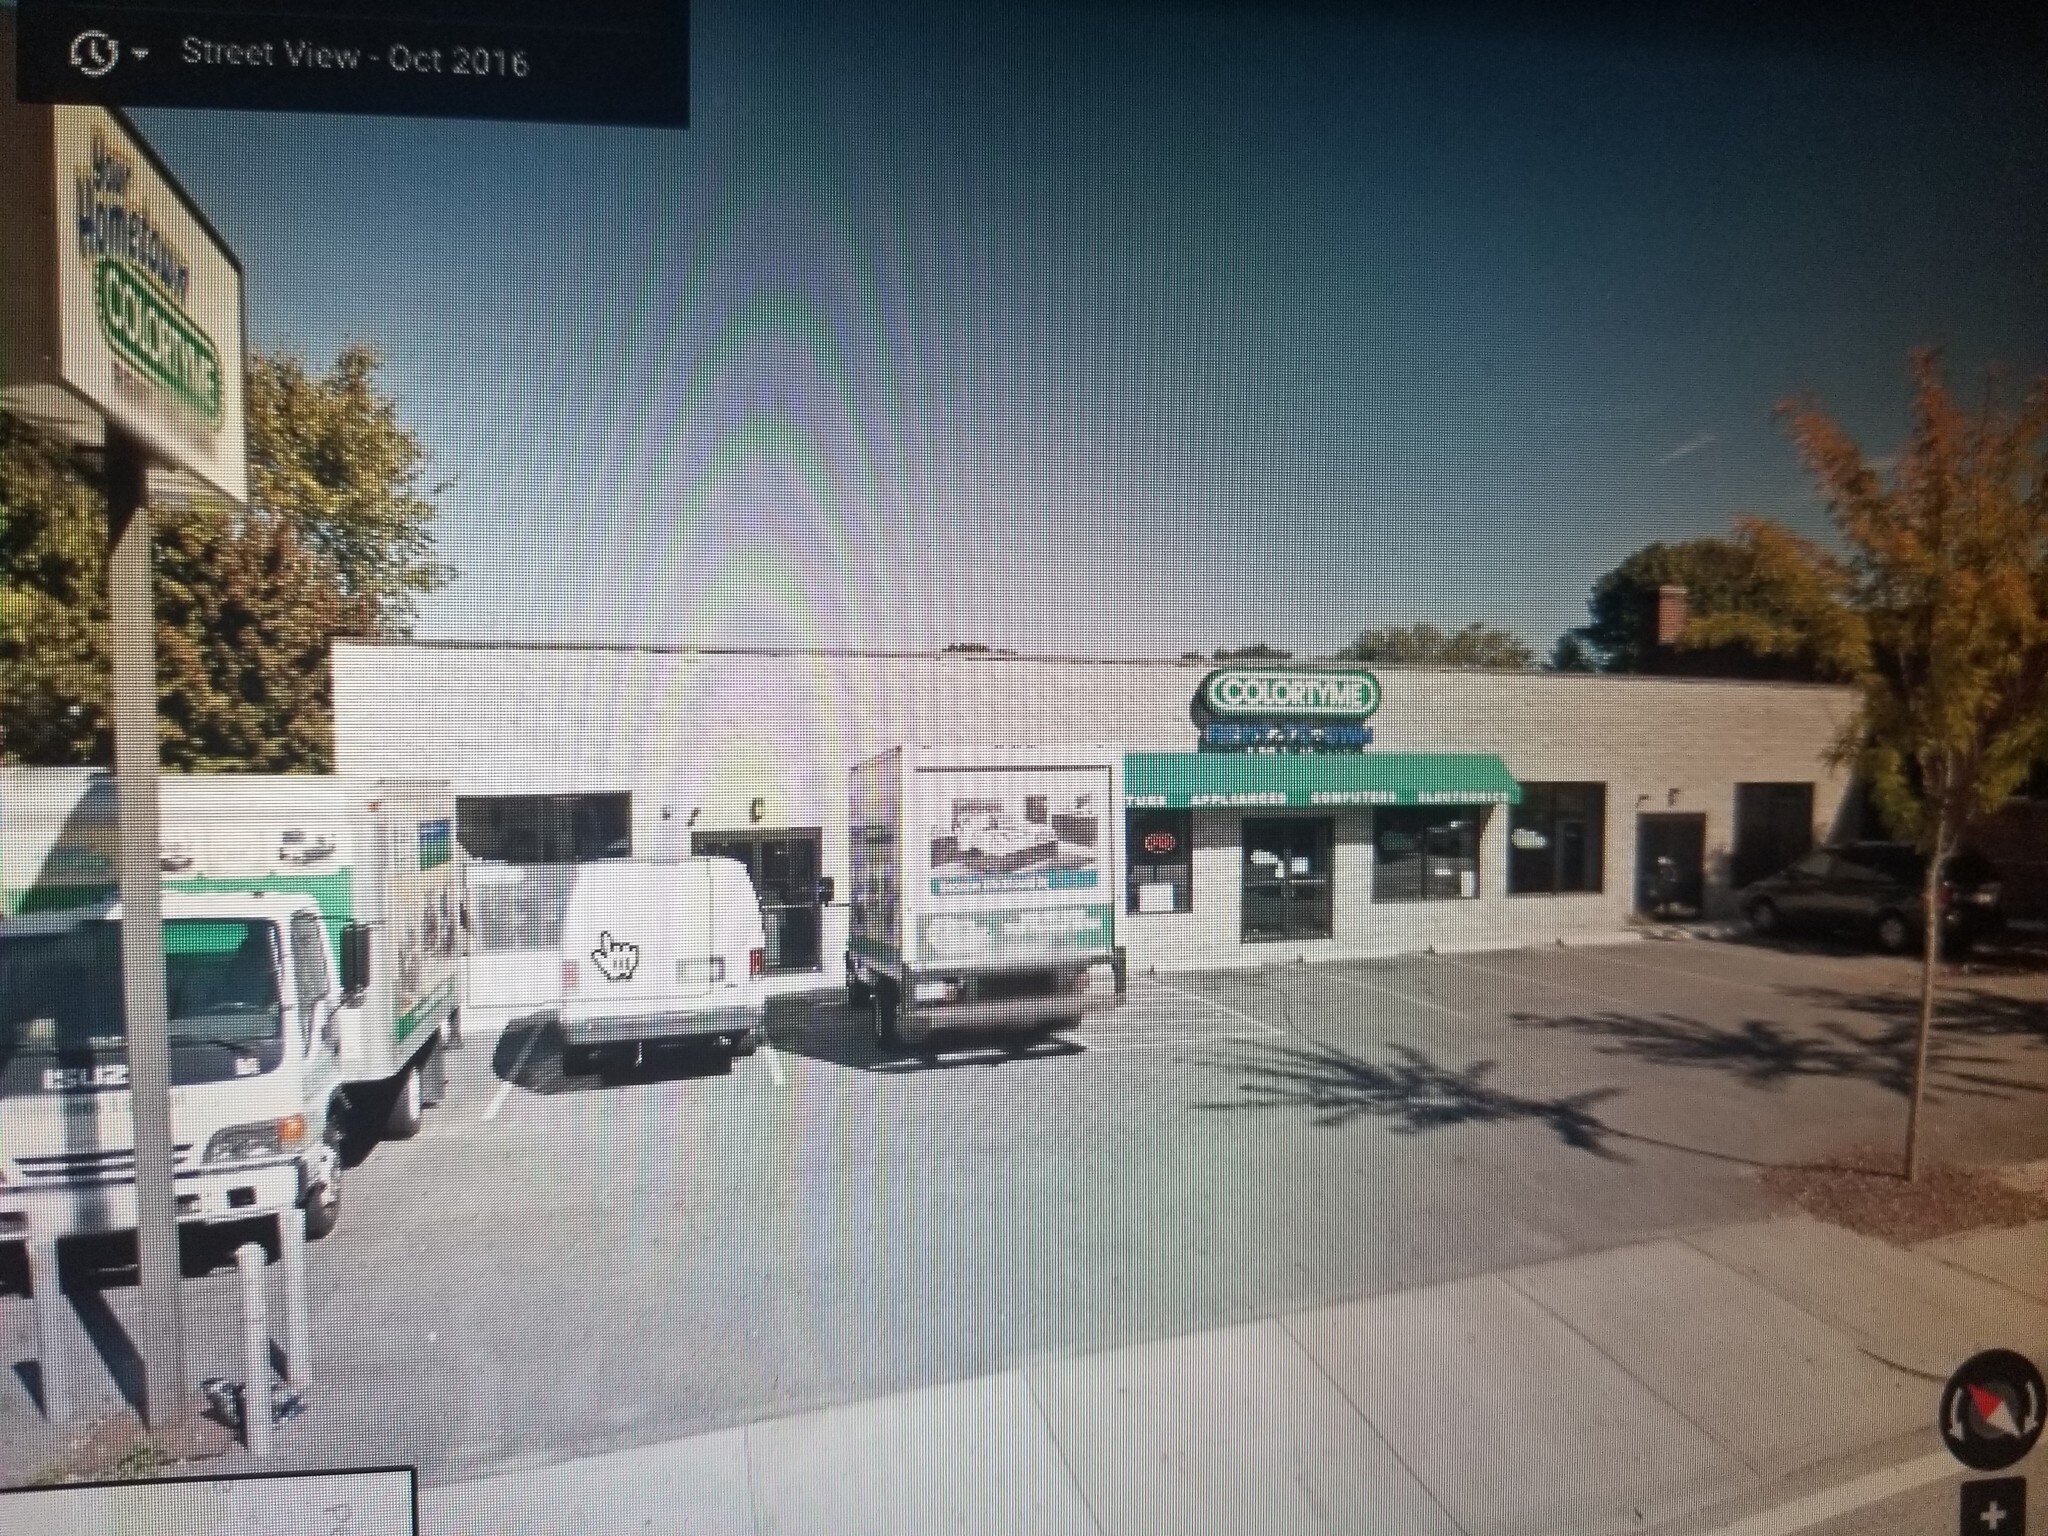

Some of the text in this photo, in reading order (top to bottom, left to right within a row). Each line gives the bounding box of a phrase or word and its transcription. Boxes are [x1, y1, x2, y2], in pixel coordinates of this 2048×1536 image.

[181, 36, 273, 68] Street
[284, 38, 361, 70] View
[388, 43, 441, 74] Oct
[451, 48, 531, 78] 2016
[77, 178, 190, 298] Hometown
[1221, 677, 1363, 708] COLORTYME
[1190, 791, 1287, 806] APPLIANCES
[1309, 790, 1398, 805] COMPUTERS
[1417, 790, 1511, 805] ELECTRONICS
[43, 1064, 130, 1090] ISUZ
